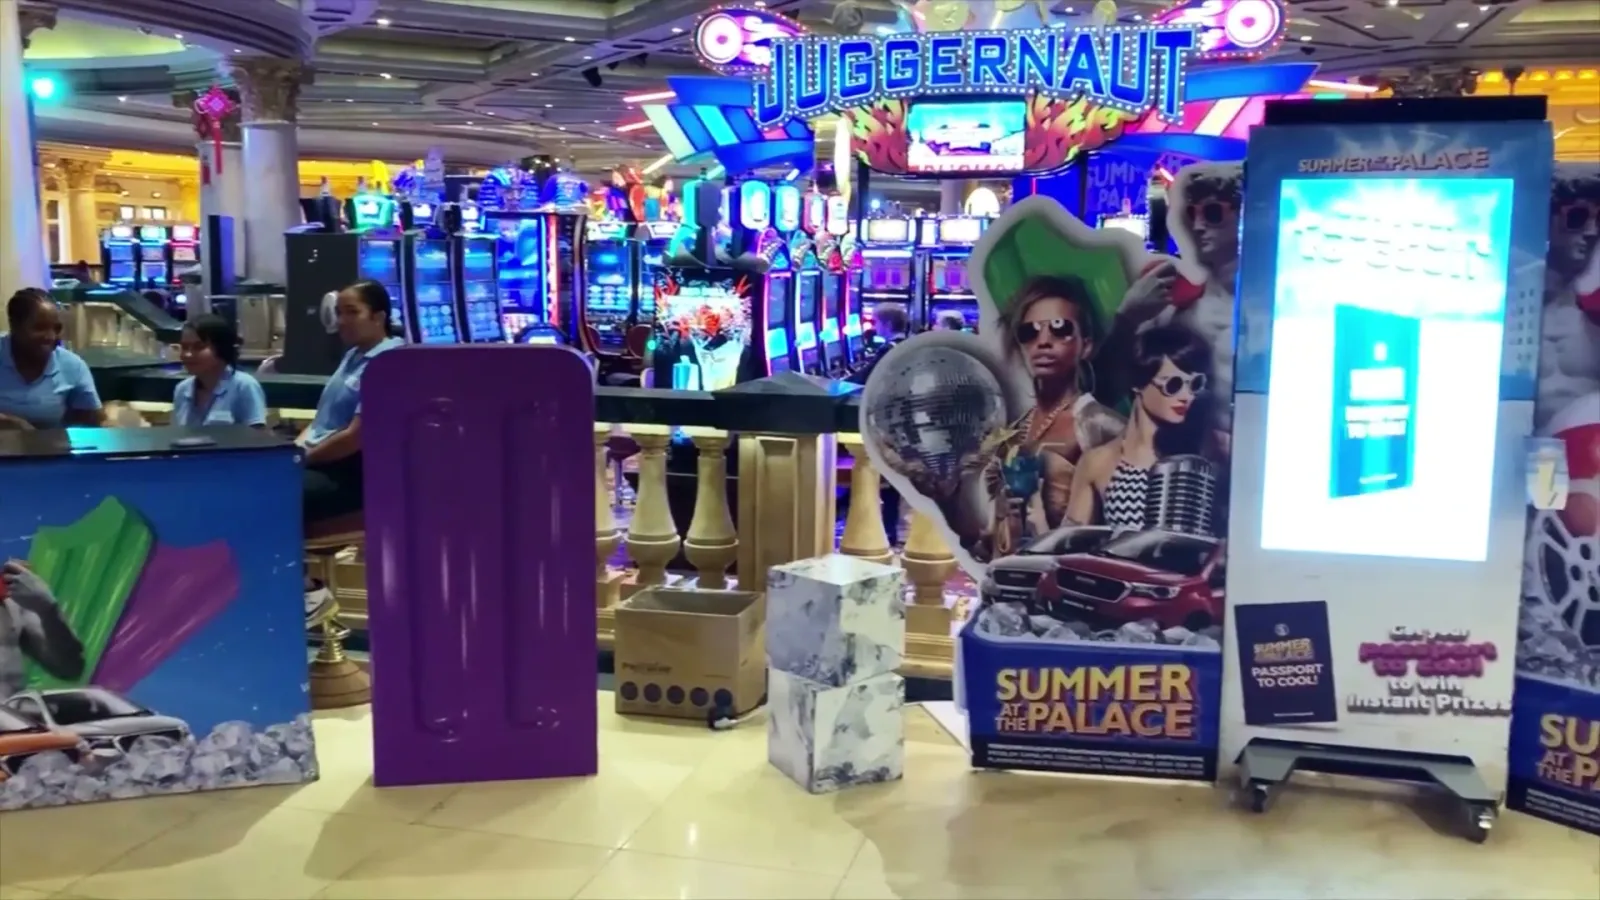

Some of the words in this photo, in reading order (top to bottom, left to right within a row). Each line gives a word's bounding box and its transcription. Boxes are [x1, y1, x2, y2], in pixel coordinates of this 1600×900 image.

[756, 28, 1195, 126] JUGGERNAUT
[1298, 155, 1370, 173] SUMMER
[1392, 147, 1491, 172] PALACE
[1251, 663, 1324, 677] PASSPORT
[1256, 678, 1276, 688] TO
[1277, 675, 1318, 687] COOL!
[995, 663, 1194, 702] SUMMER
[1389, 678, 1414, 697] to
[1416, 675, 1463, 697] win
[1000, 702, 1022, 717] AT
[1435, 693, 1512, 717] Prizes
[994, 716, 1027, 732] THE
[1027, 700, 1195, 738] PALACE
[1542, 749, 1569, 767] AT
[1535, 761, 1574, 784] THE
[1572, 754, 1600, 792] P
